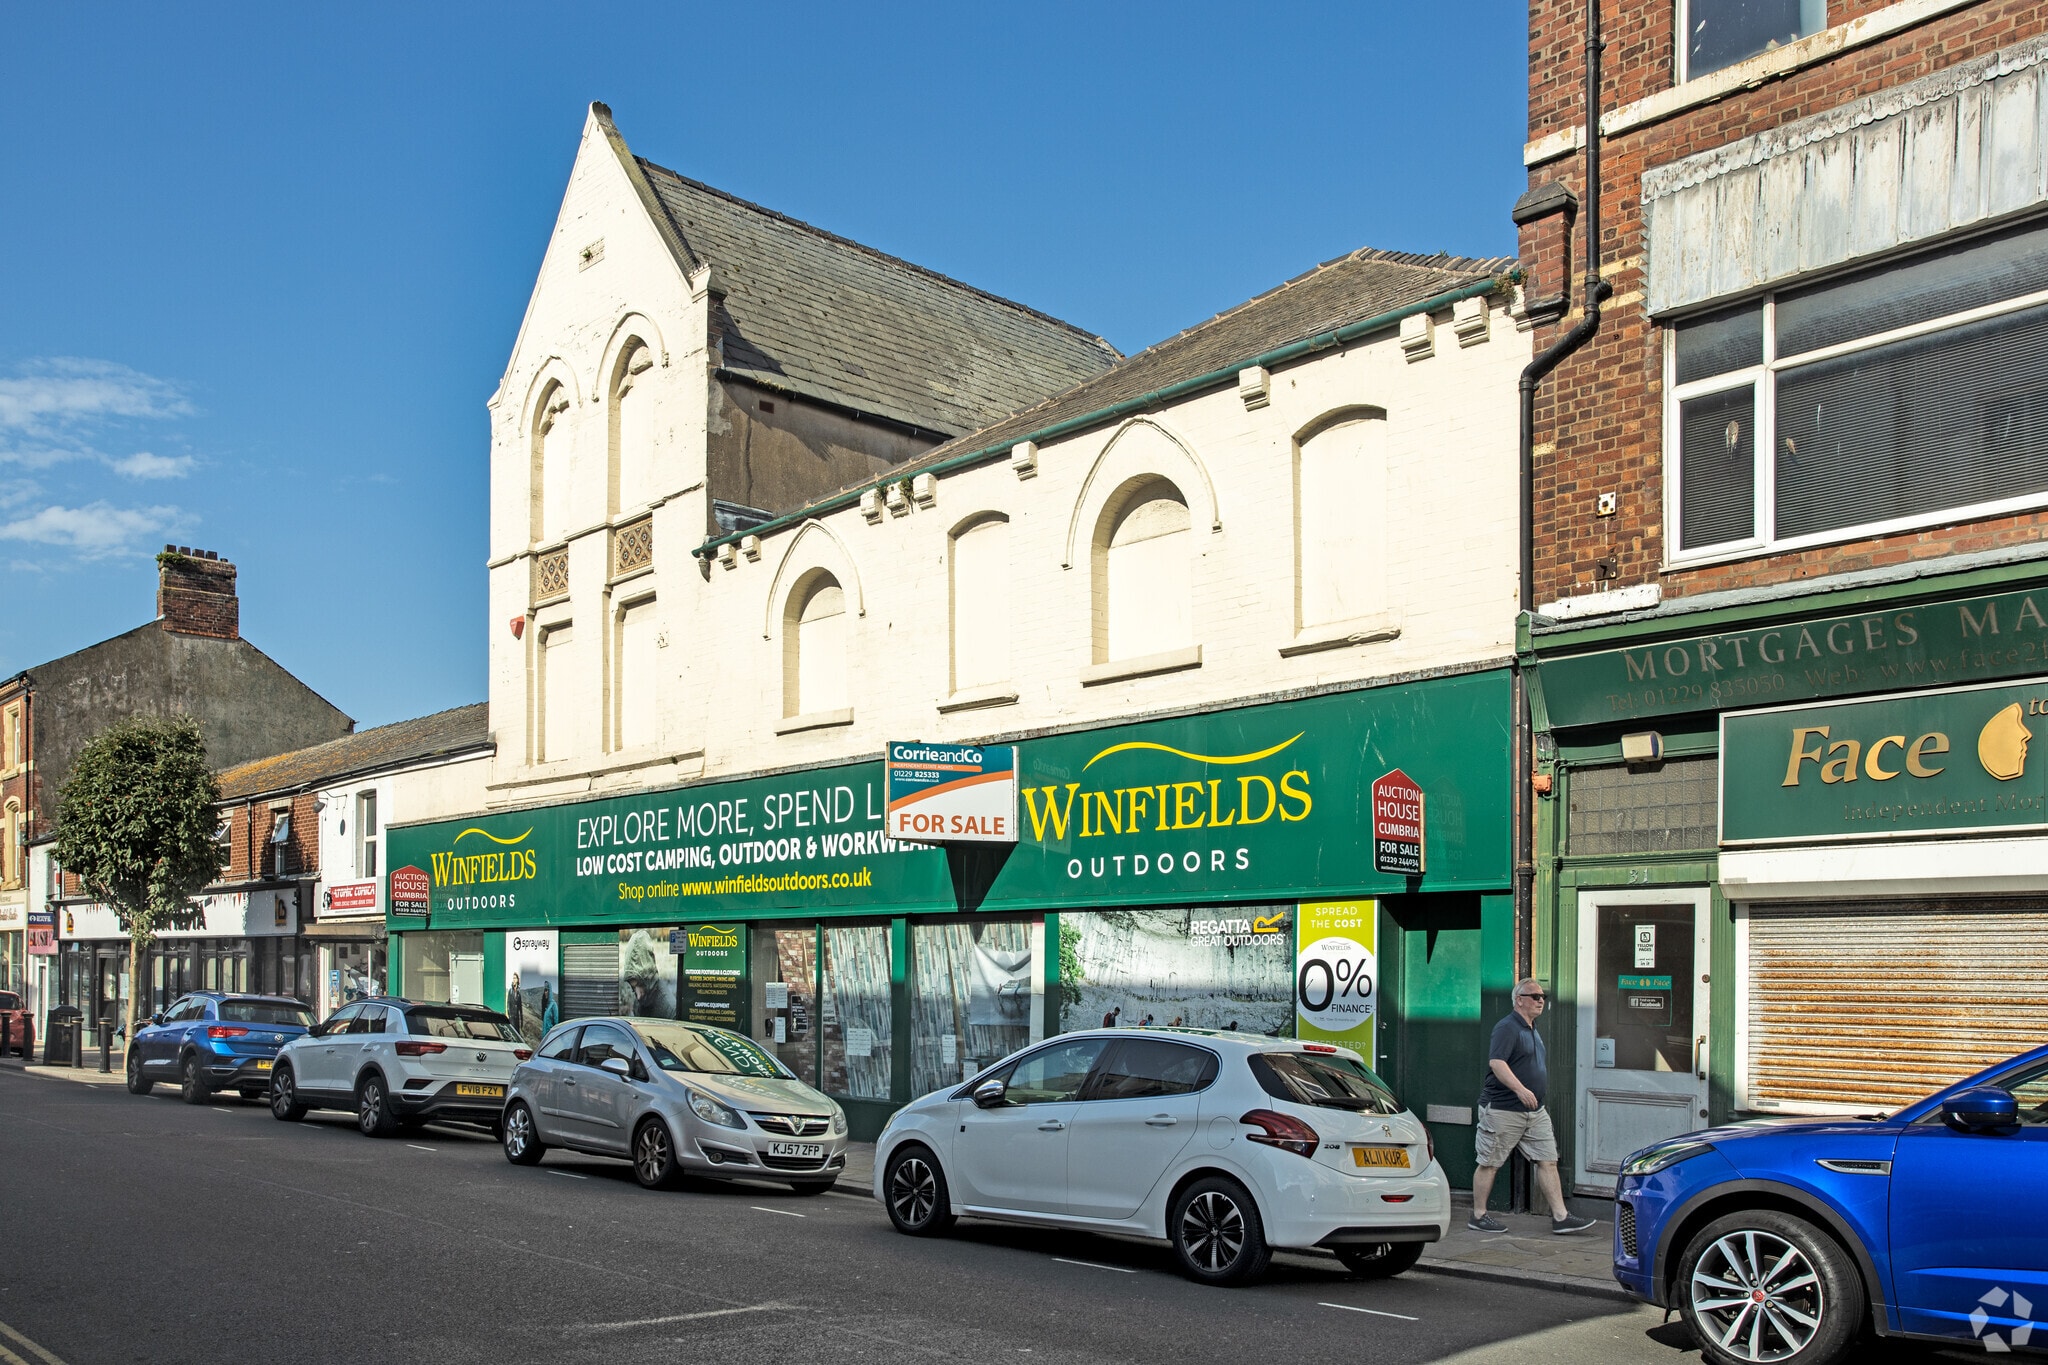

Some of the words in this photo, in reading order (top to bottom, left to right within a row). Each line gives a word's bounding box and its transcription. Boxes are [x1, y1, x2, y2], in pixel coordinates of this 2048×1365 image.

[1624, 612, 1918, 682] MORTGAGES
[1958, 596, 2048, 638] MA
[1606, 693, 1639, 712] Tel:
[1644, 685, 1703, 706] 01229
[1711, 673, 1785, 700] 835050
[1804, 664, 1866, 688] Web:
[893, 746, 983, 764] CorrieandCo
[1781, 726, 1950, 787] Face
[914, 771, 939, 779] 825333
[1377, 784, 1420, 802] AUCTION
[1021, 770, 1312, 842] WINFIELDS
[1377, 800, 1420, 821] HOUSE
[1843, 796, 1988, 822] Independent
[577, 808, 670, 849] EXPLORE
[677, 798, 754, 839] MORE,
[763, 785, 855, 831] SPEND
[899, 813, 945, 833] FOR
[950, 815, 1005, 835] SALE
[1378, 822, 1420, 838] CUMBRIA
[576, 855, 604, 877] LOW
[607, 851, 643, 874] COST
[645, 845, 716, 871] CAMPING,
[719, 837, 802, 866] OUTDOOR
[806, 836, 817, 859] &
[821, 830, 937, 858] WORKW
[1380, 841, 1397, 854] FOR
[1399, 843, 1419, 856] SALE
[430, 849, 537, 887] WINFIELDS
[1067, 848, 1249, 879] OUTDOORS
[1380, 855, 1398, 865] 01229
[1398, 857, 1419, 867] 244034
[394, 873, 428, 881] AUCTION
[618, 881, 644, 903] Shop
[647, 880, 679, 898] online
[681, 866, 872, 896] www.winfieldsoutdoors.co.uk
[394, 881, 427, 891] HOUSE
[394, 891, 428, 899] CUMBRIA
[447, 894, 515, 911] OUTDOORS
[1315, 906, 1358, 916] SPREAD
[1190, 919, 1251, 935] REGATTA
[1311, 919, 1330, 928] THE
[1334, 919, 1363, 928] COST
[522, 938, 550, 950] sprayway
[688, 933, 738, 947] WINFIELDS
[1190, 935, 1223, 948] GREAT
[1224, 934, 1285, 947] OUTDOORS
[1299, 958, 1373, 1012] 0%
[1311, 1039, 1366, 1050] RESTED?
[461, 1084, 480, 1094] FV18
[482, 1086, 498, 1096] FZY
[773, 1143, 800, 1155] KJ57
[802, 1144, 820, 1156] ZFP
[1384, 1150, 1403, 1166] KUR
